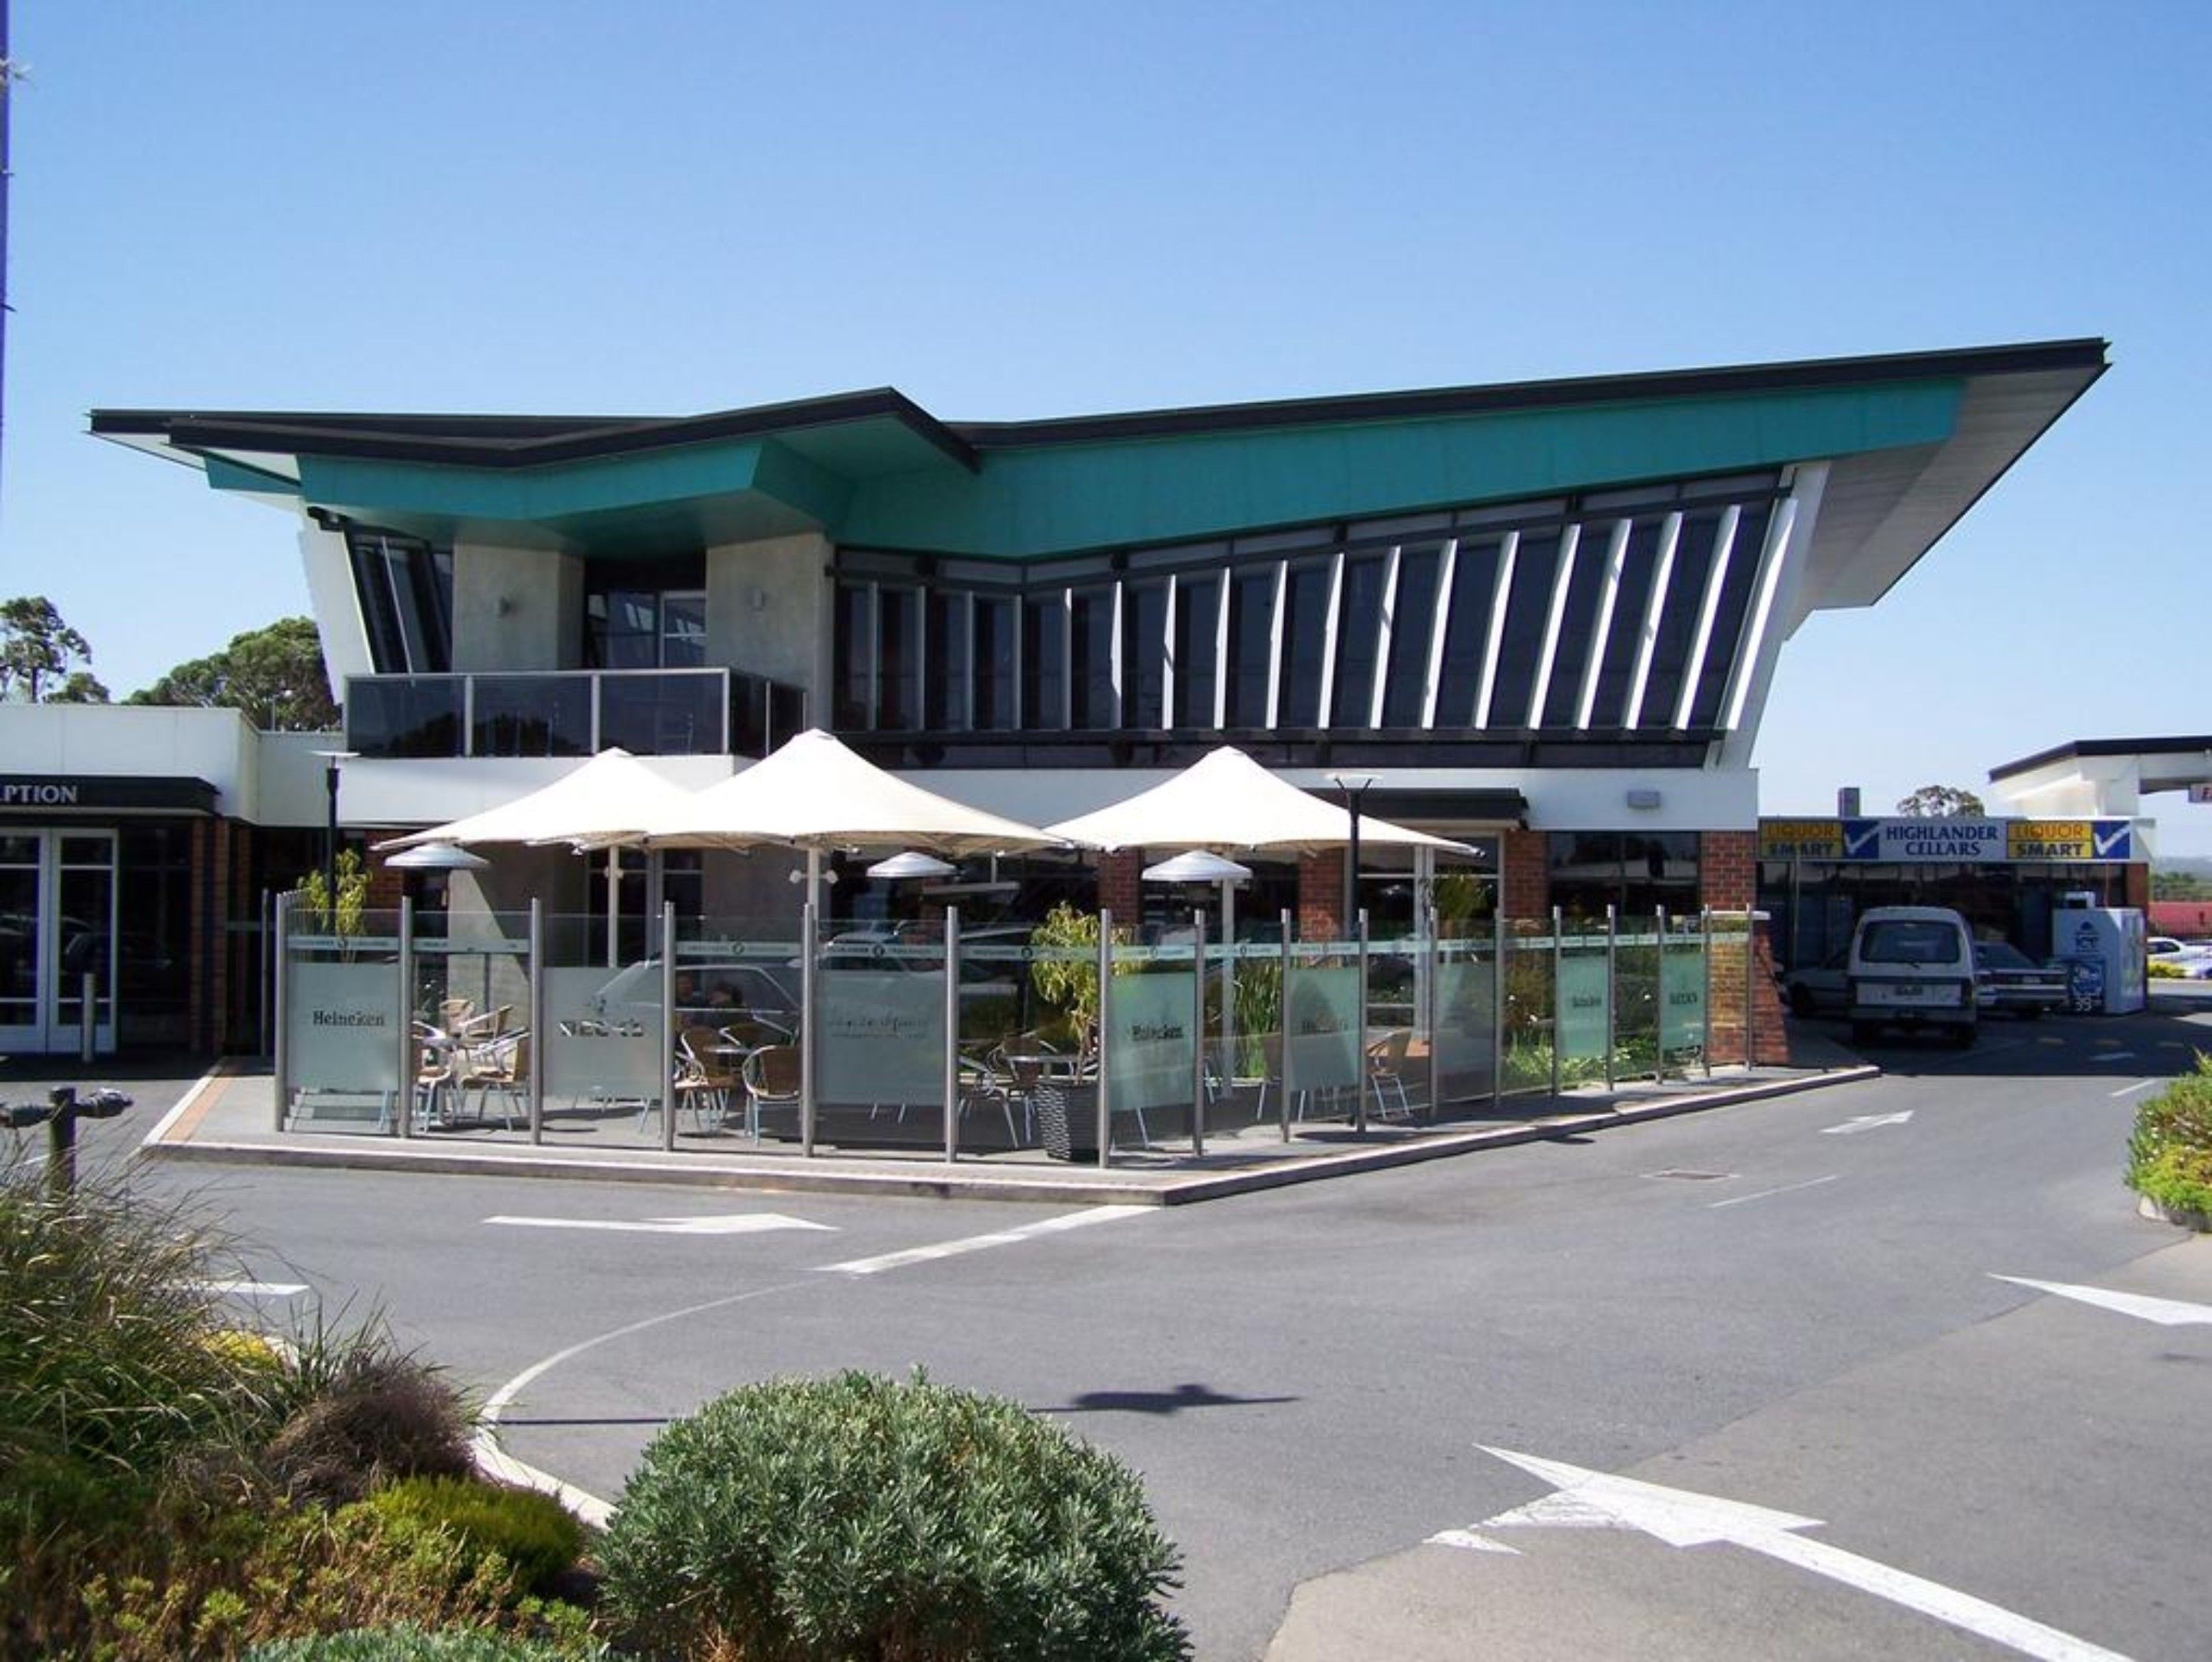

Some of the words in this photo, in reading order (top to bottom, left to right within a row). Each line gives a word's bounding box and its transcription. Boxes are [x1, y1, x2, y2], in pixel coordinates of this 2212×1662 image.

[0, 785, 77, 803] PTION
[1767, 823, 1834, 839] LIQUOR
[1886, 826, 1998, 840] HIGHLANDER
[2015, 823, 2083, 839] LIQUOR
[1769, 842, 1833, 856] SMART
[1905, 842, 1982, 856] CELLARS
[2017, 843, 2084, 856] SMART
[313, 1010, 385, 1026] Heineken
